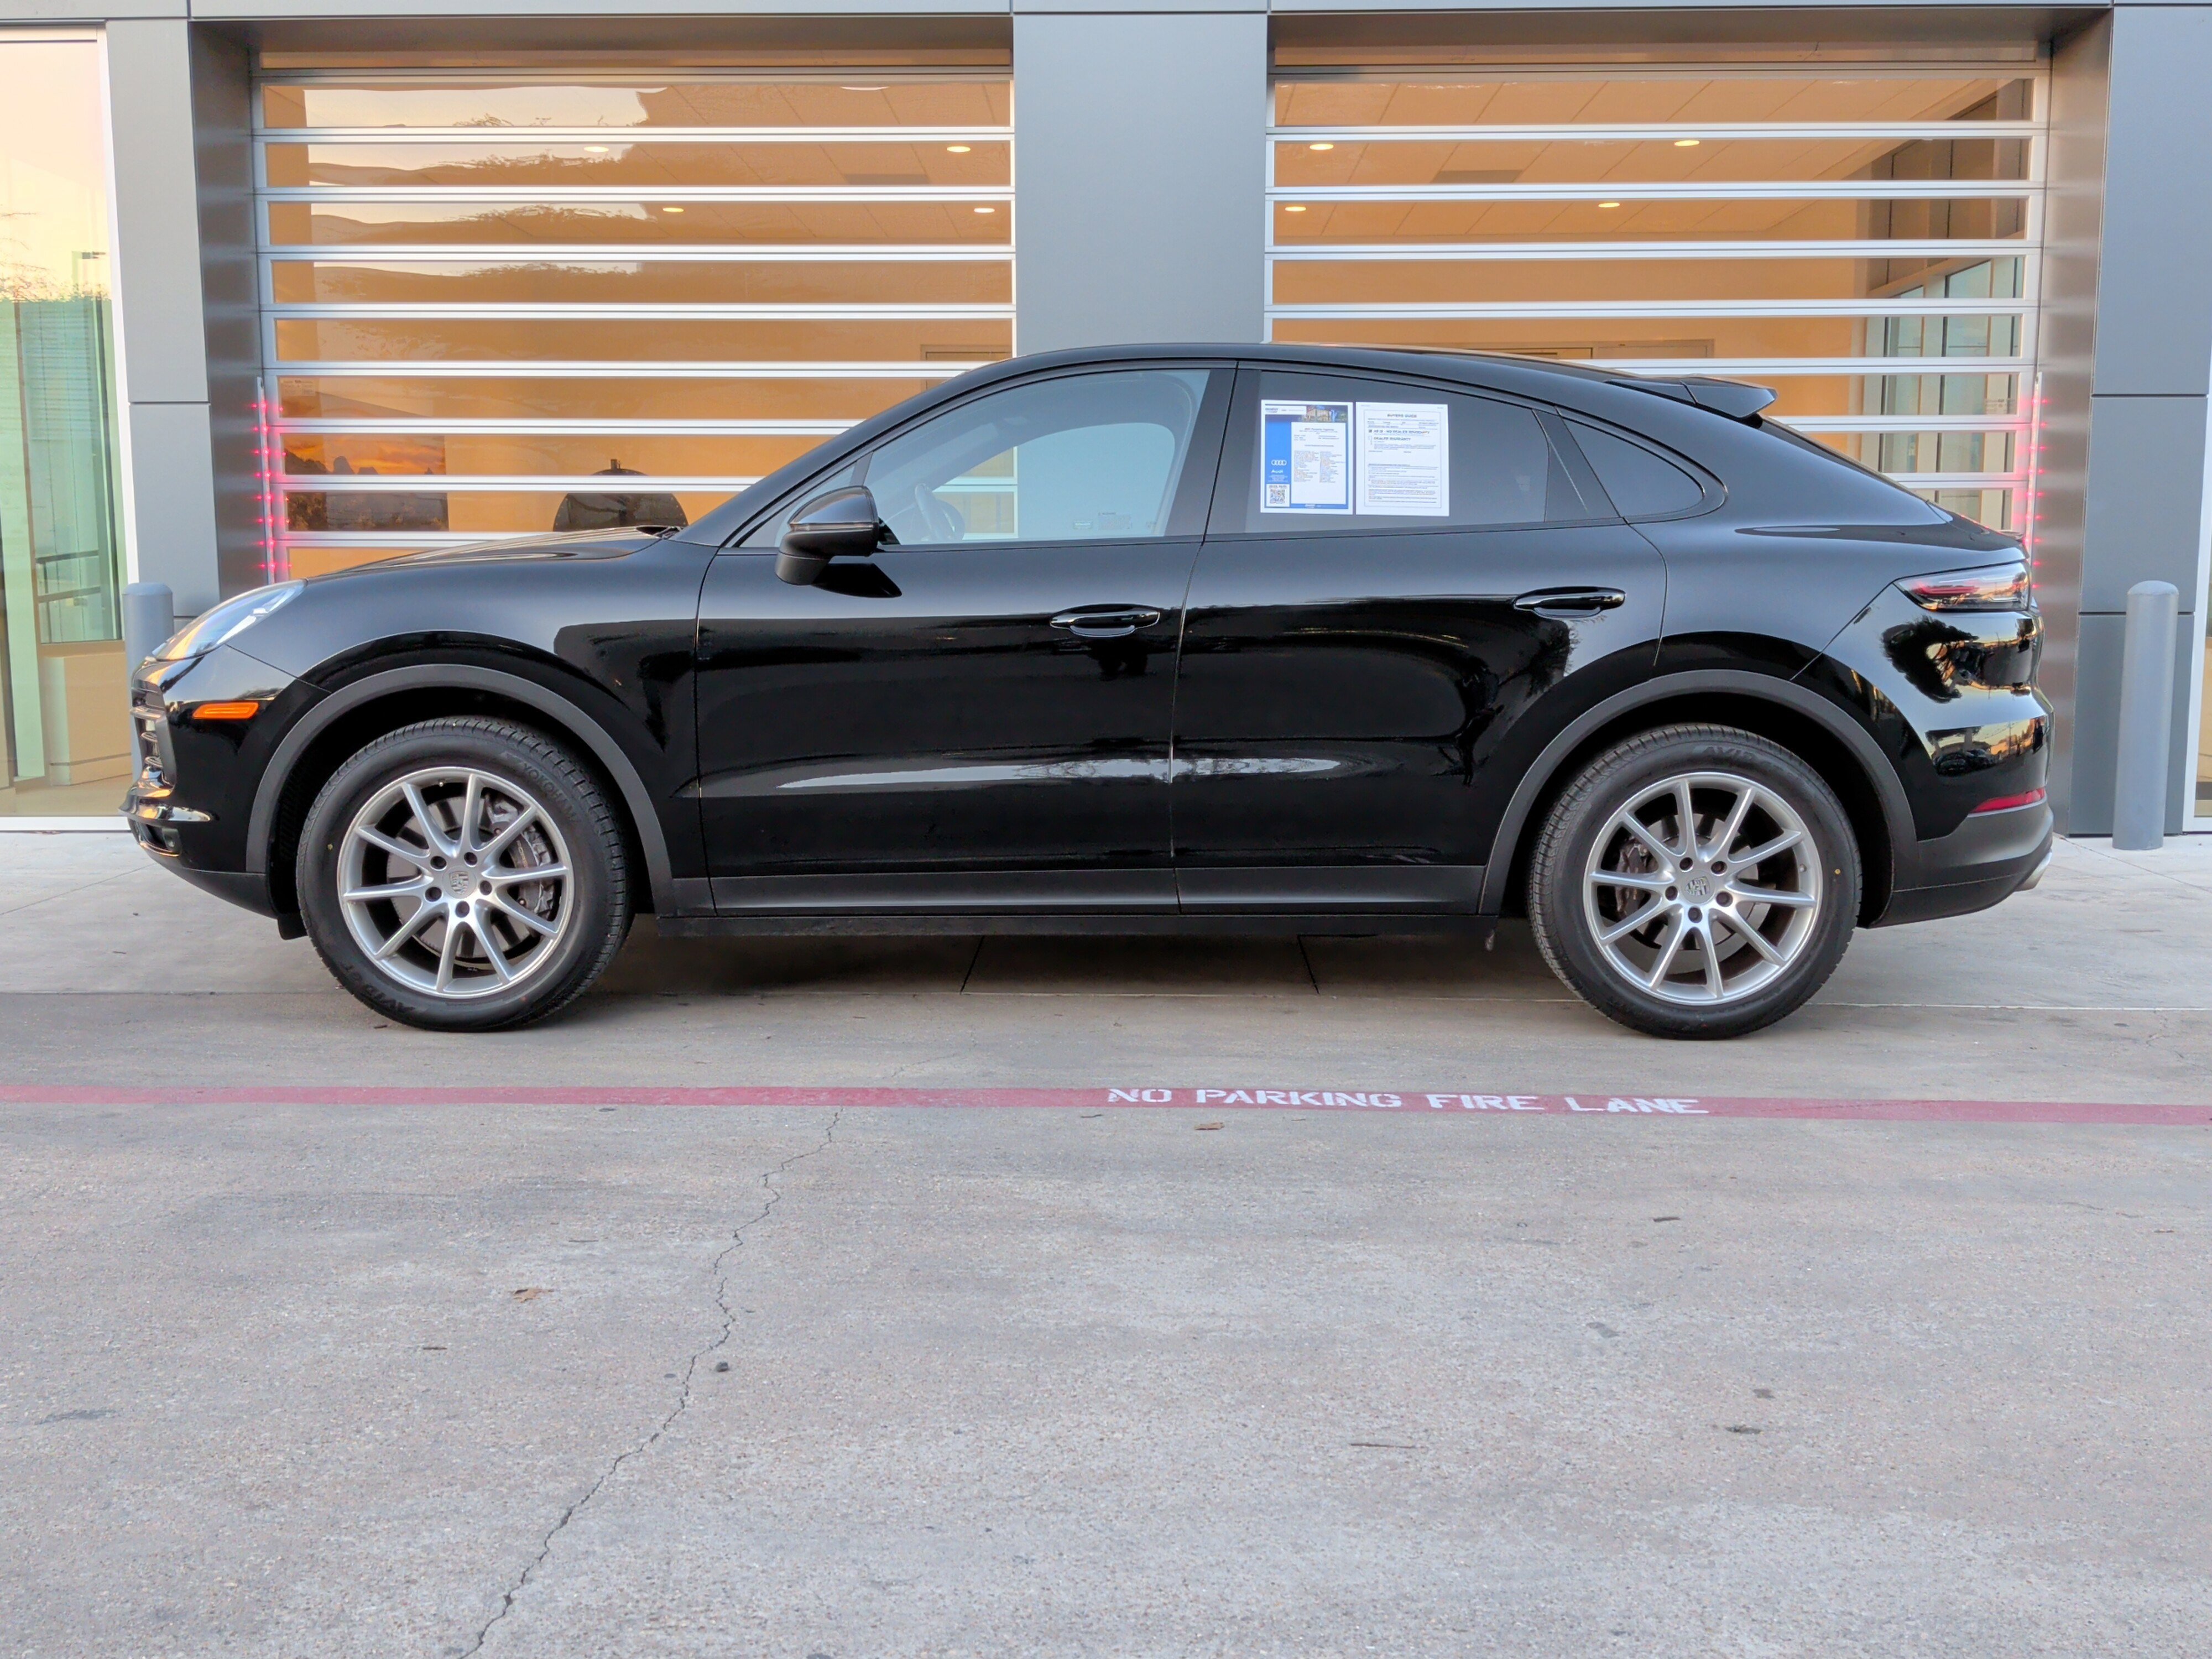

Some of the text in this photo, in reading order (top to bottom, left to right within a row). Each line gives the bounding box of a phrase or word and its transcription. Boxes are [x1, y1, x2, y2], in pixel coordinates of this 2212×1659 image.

[1108, 1088, 1709, 1113] NO PARKING FIRE LANE
